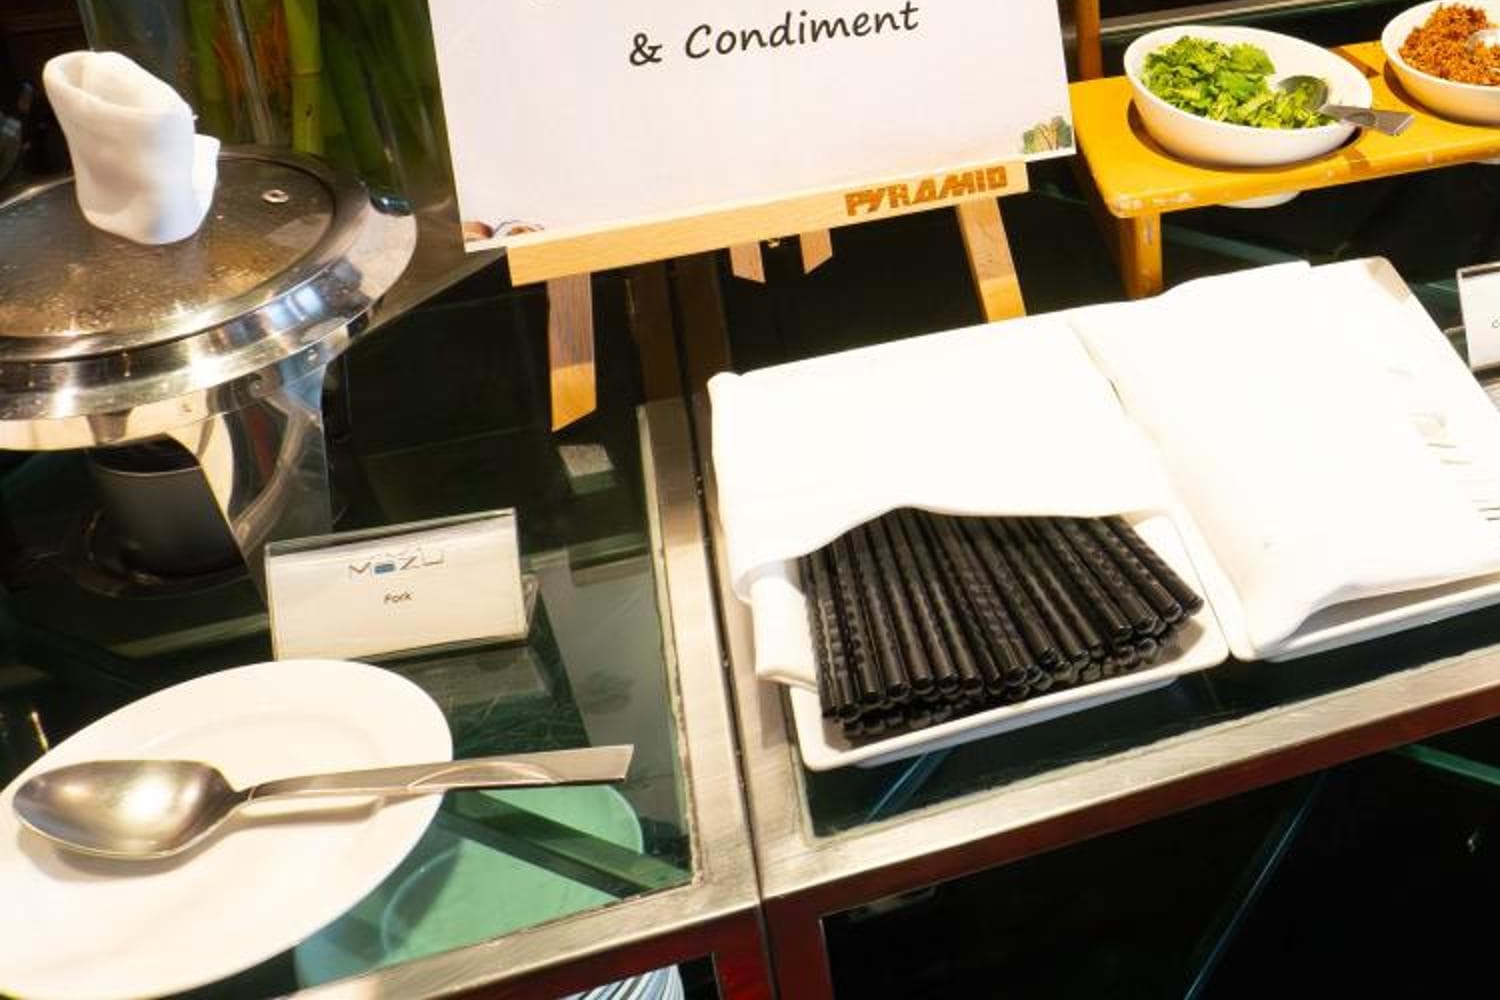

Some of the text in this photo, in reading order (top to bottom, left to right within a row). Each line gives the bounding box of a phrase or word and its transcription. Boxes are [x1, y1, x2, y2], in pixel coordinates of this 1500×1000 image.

[629, 0, 920, 67] & Condiment
[844, 165, 1008, 217] PYRAMID
